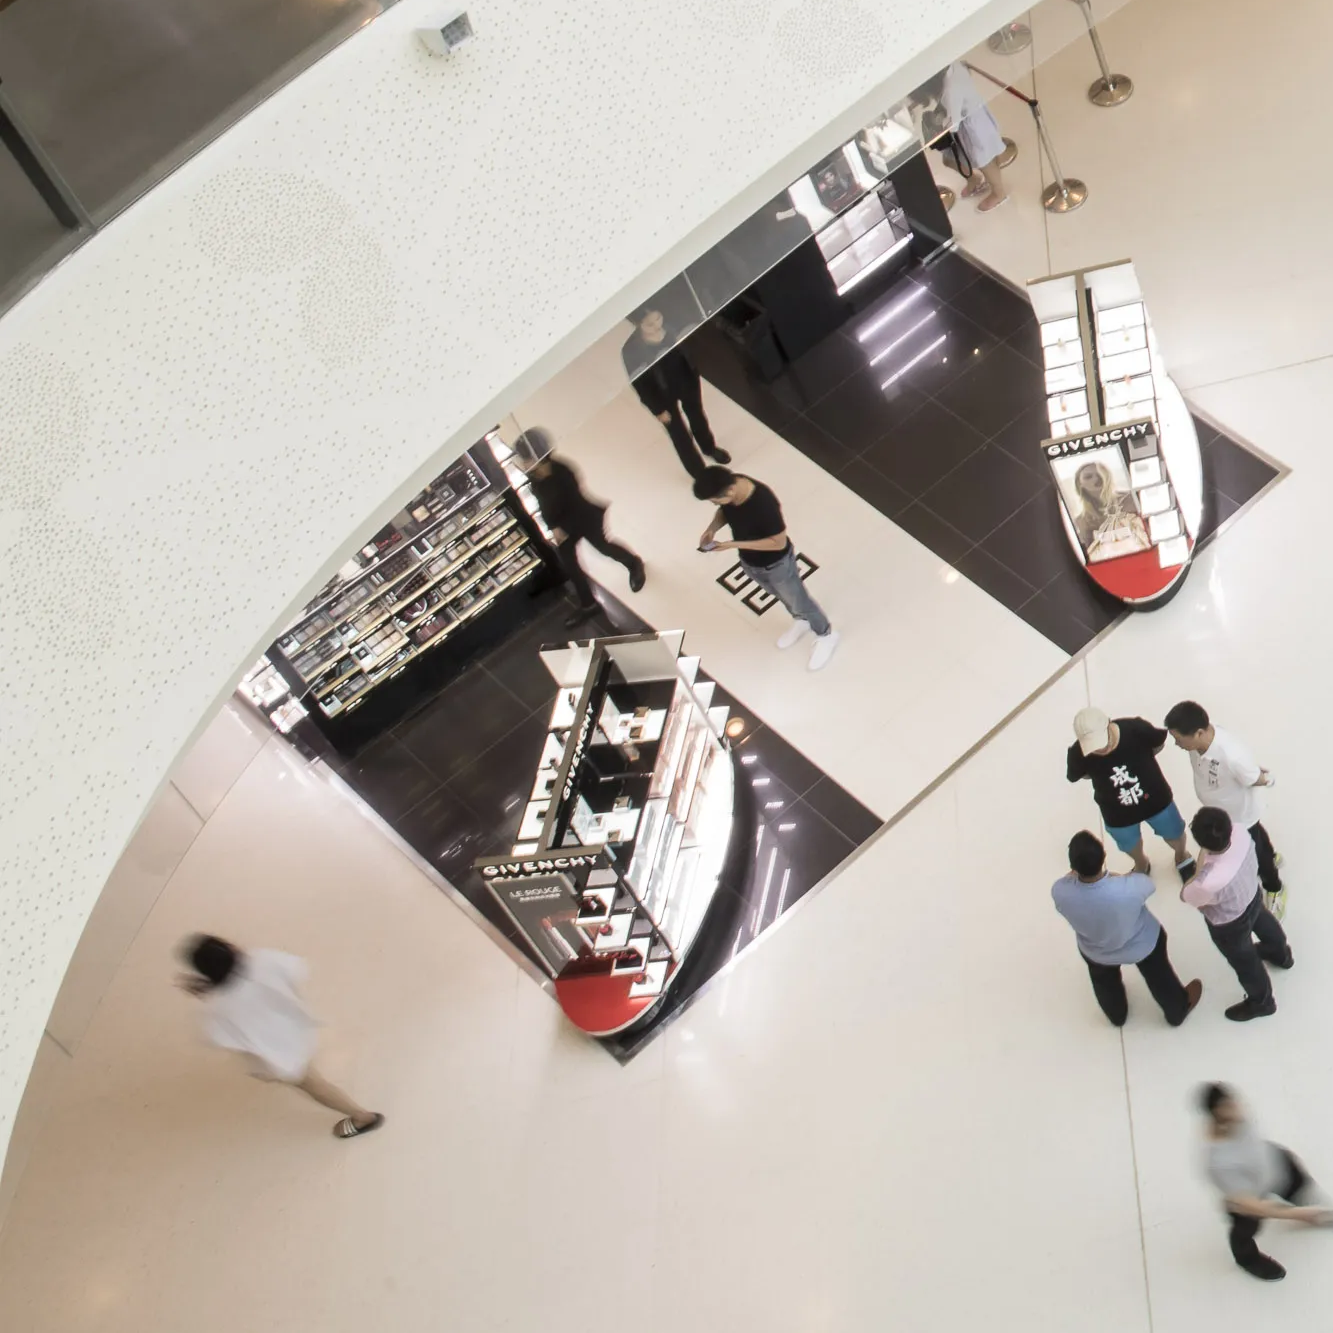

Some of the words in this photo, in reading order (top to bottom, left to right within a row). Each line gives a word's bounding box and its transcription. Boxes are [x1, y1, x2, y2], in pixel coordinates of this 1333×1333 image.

[1047, 423, 1148, 456] GIVENCHY
[563, 701, 594, 802] GIVENCHY
[1109, 764, 1144, 806] 成都
[483, 854, 597, 877] GIVENCHY
